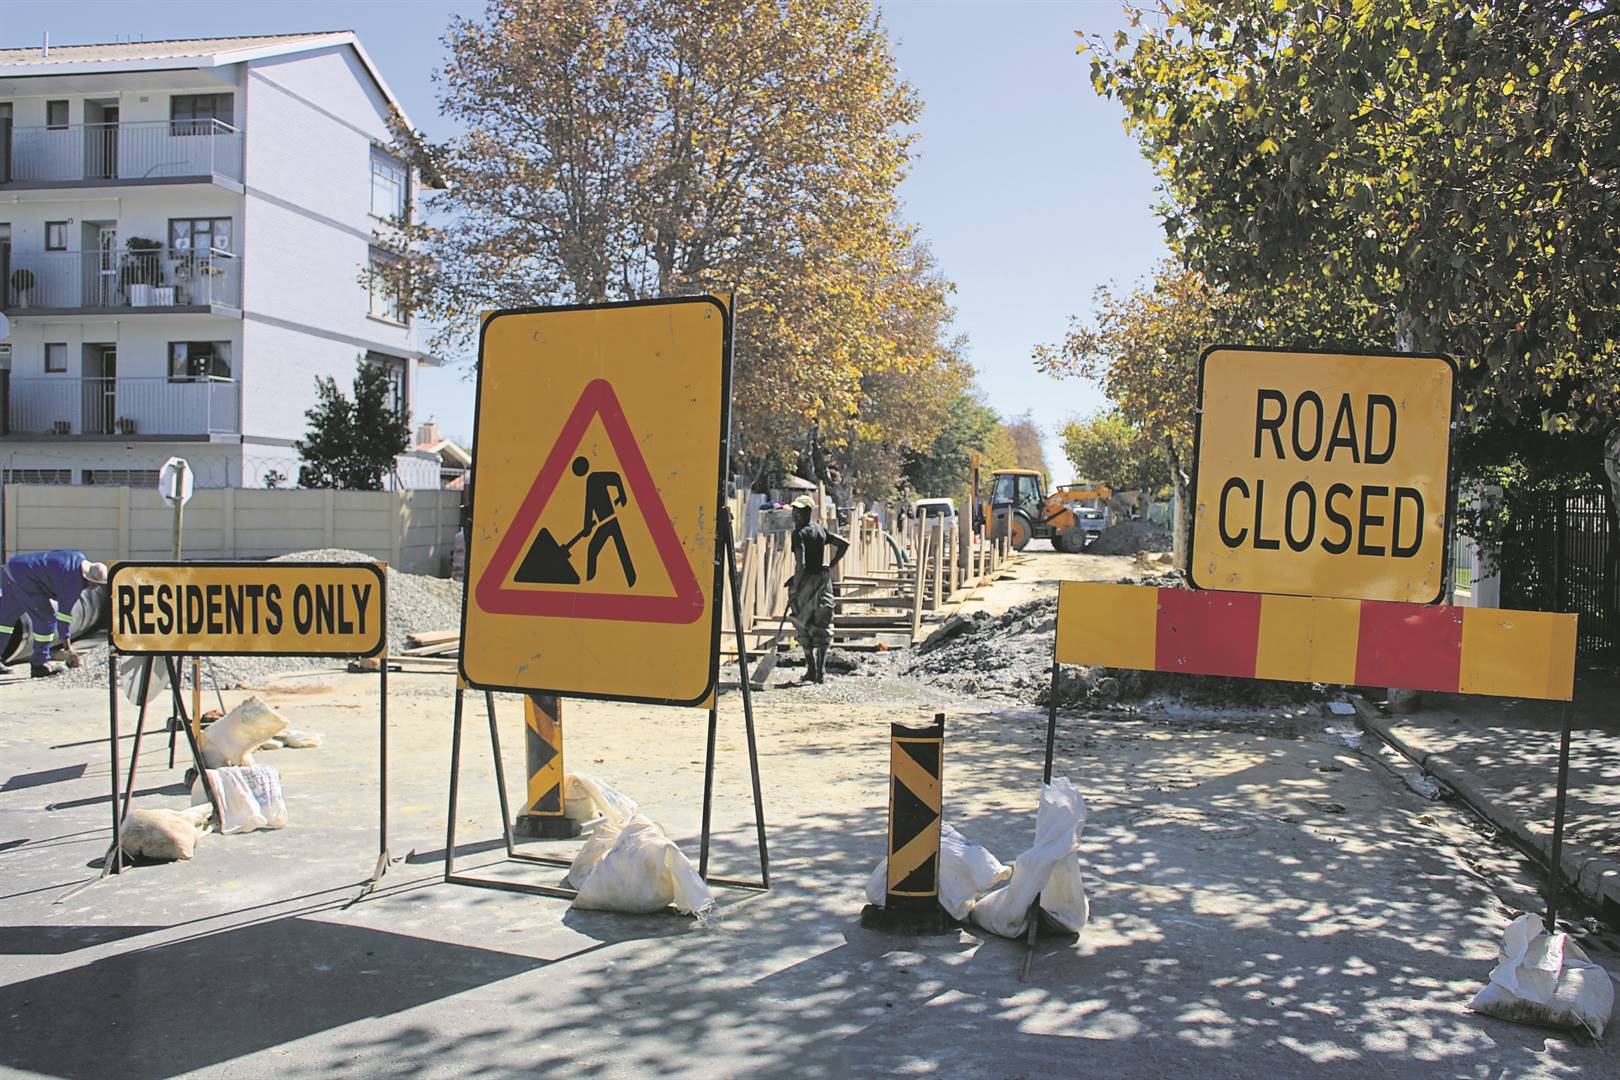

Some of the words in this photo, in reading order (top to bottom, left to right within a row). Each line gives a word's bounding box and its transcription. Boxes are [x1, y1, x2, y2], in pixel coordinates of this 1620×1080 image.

[1254, 389, 1397, 465] ROAD
[1218, 476, 1425, 558] CLOSED
[118, 584, 283, 635] RESIDENTS
[293, 583, 372, 635] ONLY
